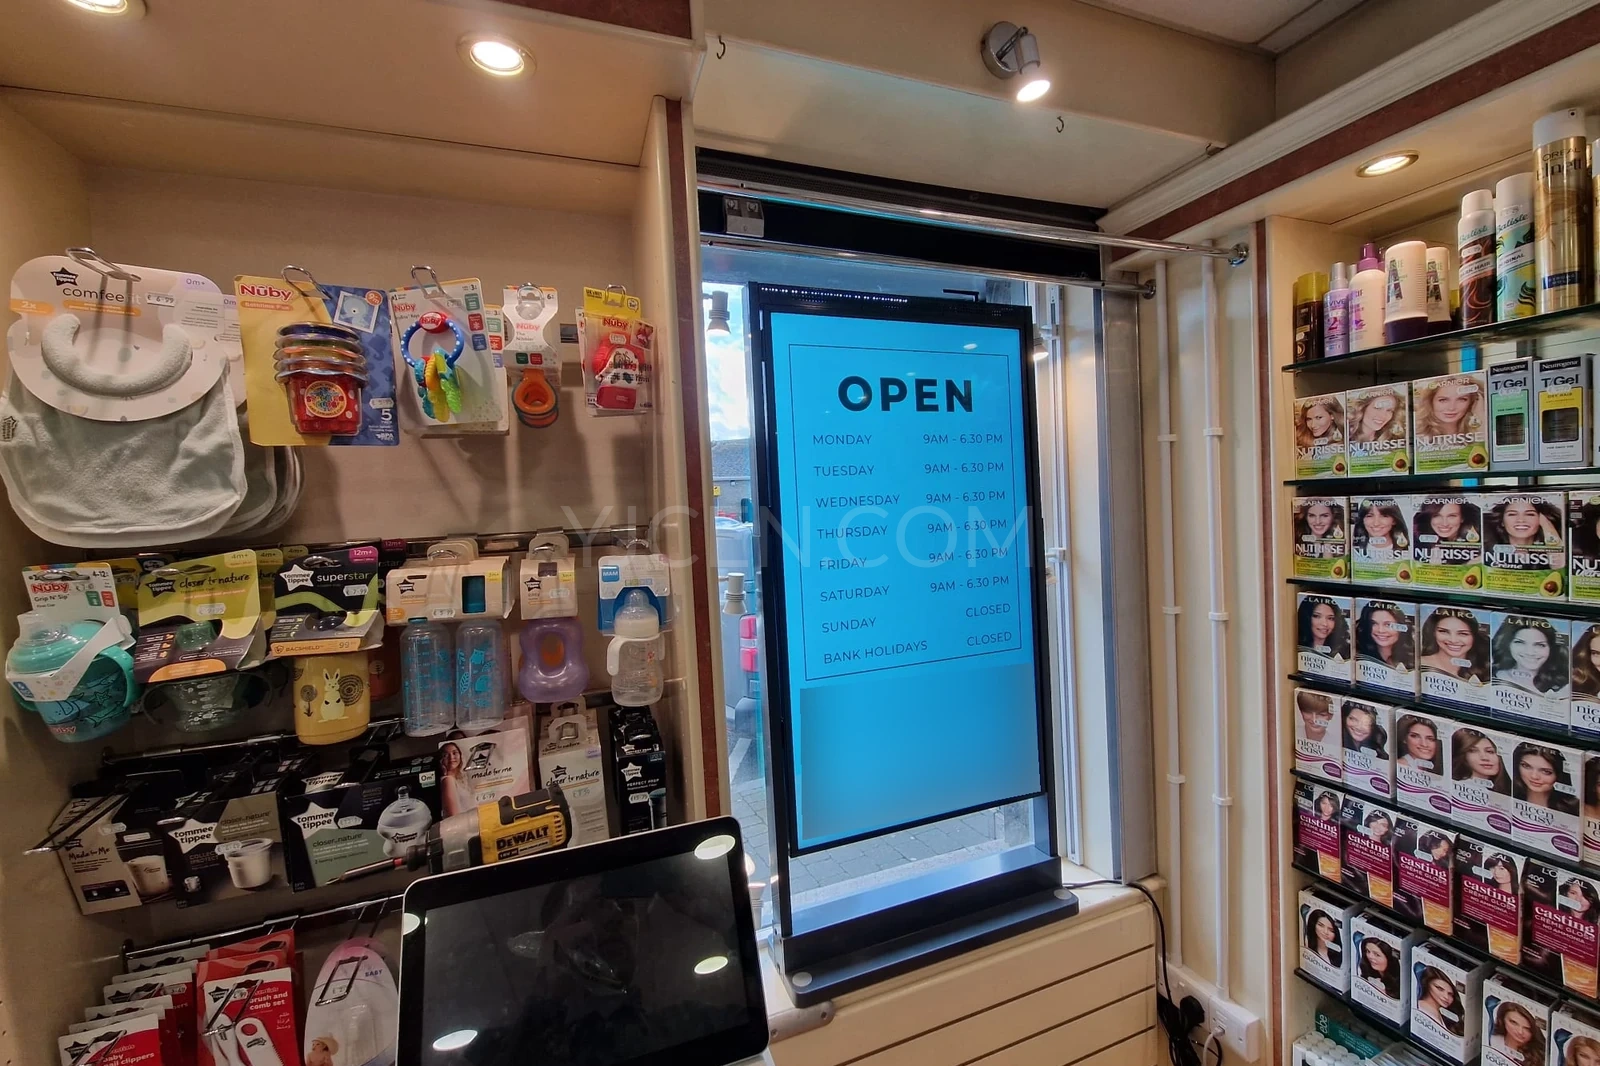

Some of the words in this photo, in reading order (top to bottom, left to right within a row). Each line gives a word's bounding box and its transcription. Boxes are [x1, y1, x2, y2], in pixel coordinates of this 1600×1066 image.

[838, 375, 973, 413] OPEN
[381, 408, 393, 421] 5
[813, 434, 872, 445] MONDAY
[923, 434, 948, 444] 9AM
[959, 434, 983, 444] 6.30
[986, 434, 1003, 444] PM
[1349, 439, 1406, 453] NUTRISSE
[1415, 431, 1485, 447] NUTRISSE
[1296, 445, 1344, 457] NUTRISSE
[814, 465, 875, 477] TUESDAY
[924, 464, 950, 474] 9AM
[961, 462, 984, 473] 6.30
[987, 462, 1004, 472] PM
[815, 494, 900, 508] WEDNESDAY
[926, 493, 951, 504] 9AM
[963, 492, 985, 502] 6.30
[989, 491, 1005, 501] PM
[817, 525, 888, 539] THURSDAY
[927, 523, 953, 534] 9AM
[964, 520, 986, 531] 6.30
[990, 519, 1007, 529] PM
[928, 552, 954, 563] 9AM
[965, 548, 988, 559] 6.30
[991, 547, 1008, 558] PM
[1295, 543, 1344, 555] NUTRISSE
[1414, 547, 1479, 561] NUTRISSE
[819, 557, 868, 571] FRIDAY
[1485, 551, 1560, 566] NUTRISSE
[218, 572, 250, 585] nature
[316, 571, 369, 583] superstar
[930, 581, 955, 593] 9AM
[966, 577, 989, 589] 6.30
[993, 576, 1009, 586] PM
[820, 585, 890, 602] SATURDAY
[965, 603, 1011, 618] CLOSED
[822, 617, 877, 633] SUNDAY
[967, 632, 1012, 647] CLOSED
[824, 649, 861, 664] BANK
[865, 641, 928, 658] HOLIDAYS
[297, 811, 335, 823] tommee
[302, 819, 332, 829] tippee
[174, 825, 214, 839] tommee
[1299, 814, 1338, 836] casting
[180, 832, 211, 844] tippee
[1347, 832, 1390, 856] casting
[1400, 855, 1447, 880] casting
[1528, 873, 1545, 884] 400
[1463, 879, 1517, 908] casting
[1534, 905, 1595, 938] casting
[274, 991, 288, 1000] and
[250, 1002, 271, 1011] comb
[121, 1052, 155, 1066] clippers
